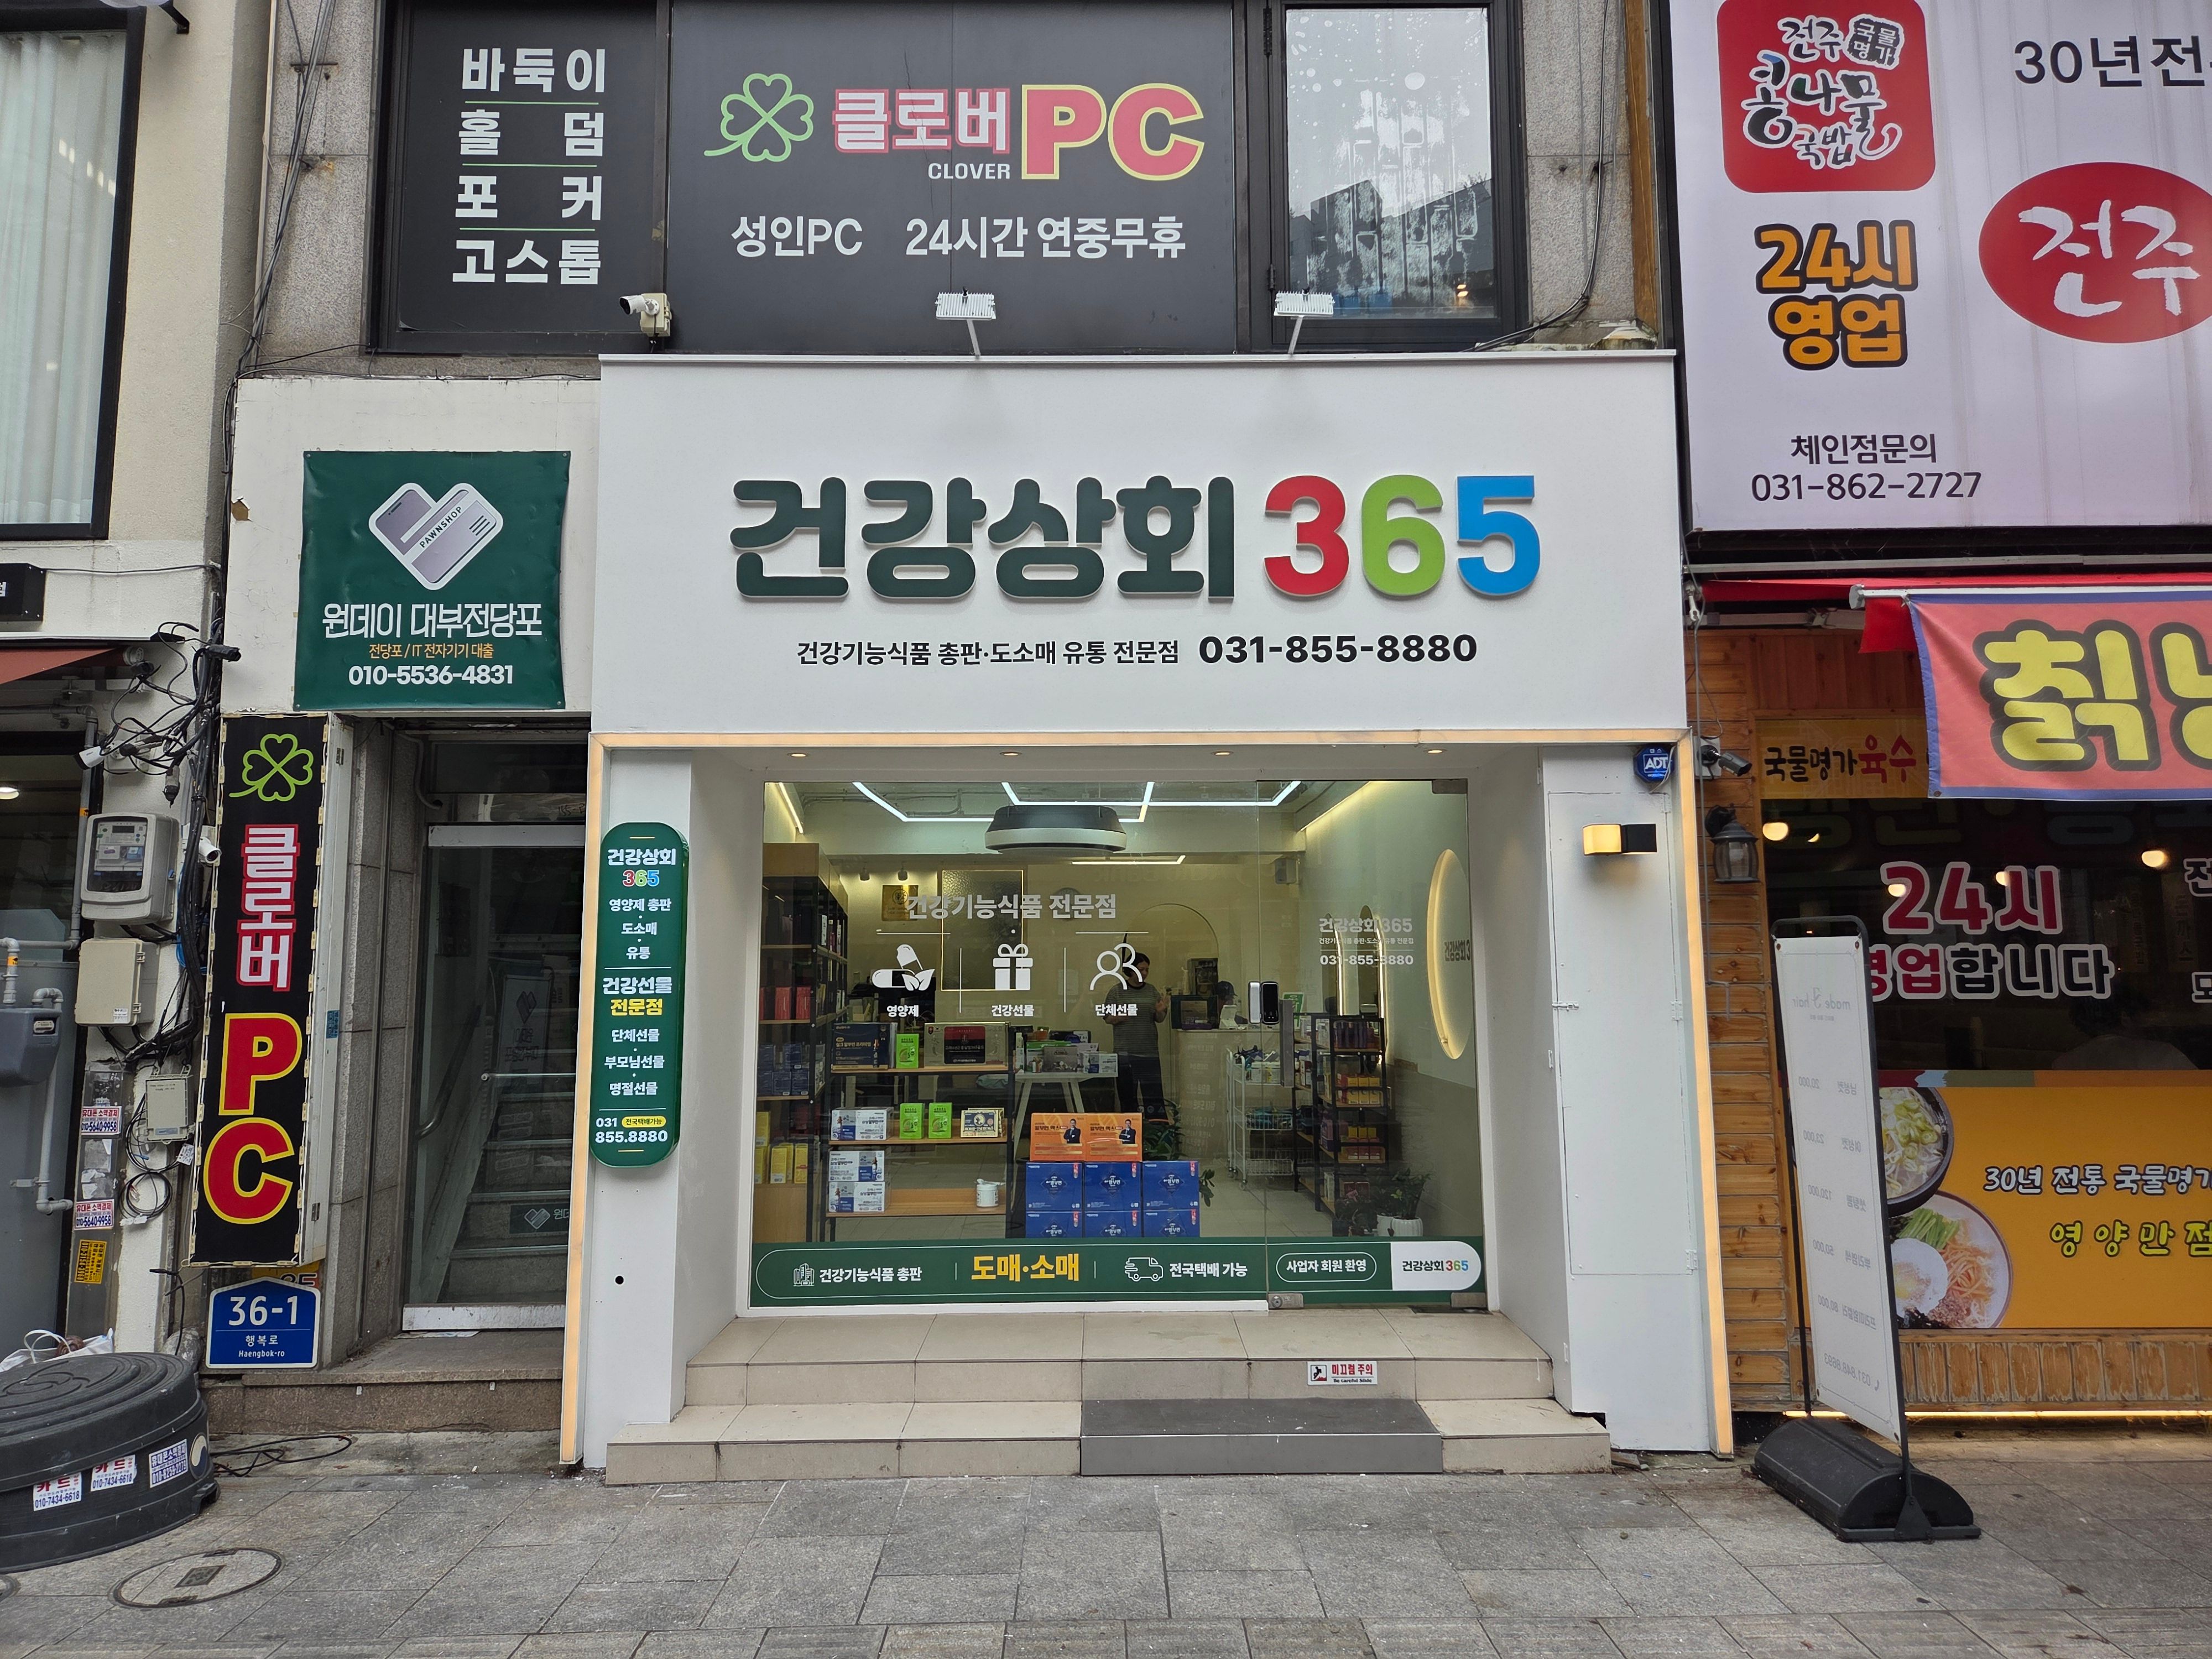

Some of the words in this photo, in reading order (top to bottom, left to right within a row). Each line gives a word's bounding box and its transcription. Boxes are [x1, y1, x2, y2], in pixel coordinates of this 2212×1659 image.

[462, 48, 605, 92] 바둑이
[2014, 36, 2212, 88] 30년전
[1744, 52, 1901, 158] 콩나물
[832, 87, 1010, 154] 클로버
[1021, 83, 1205, 181] PC
[1796, 125, 1854, 166] 국밥
[928, 163, 1010, 180] CLOVER
[732, 216, 863, 258] 성인PC
[906, 216, 1029, 259] 24시간
[1037, 215, 1186, 259] 연중무휴
[453, 240, 601, 285] 고스톱
[1755, 220, 1918, 294] 24시
[2018, 200, 2201, 317] 전주
[1768, 295, 1908, 371] 영업
[1791, 434, 1937, 466] 체인점문의
[1751, 472, 1982, 501] 031-862-2727
[420, 505, 463, 548] PAWNSHOP
[729, 476, 1235, 599] 건강상회
[1264, 473, 1540, 597] 365
[322, 603, 400, 638] 원데이
[410, 603, 542, 638] 대부전당포
[369, 644, 403, 658] 전당포
[424, 643, 468, 658] 전자기기
[471, 643, 494, 659] 대출
[797, 641, 931, 665] 건강기능식품
[937, 641, 1056, 665] 총판·도소매
[1062, 640, 1107, 664] 유통
[1113, 640, 1178, 664] 전문점
[1198, 634, 1478, 665] 031-855-8880
[348, 665, 513, 685] 010-5536-4831
[1644, 757, 1668, 769] ADT
[607, 848, 676, 866] 건강상회
[622, 870, 659, 887] 365
[609, 898, 645, 911] 영양제
[647, 898, 671, 911] 총판
[906, 894, 1042, 919] 건강기능식품
[1048, 894, 1117, 919] 전문점
[1880, 862, 2063, 935] 24시
[236, 824, 300, 992] 클로버
[621, 922, 657, 935] 도소매
[1319, 918, 1378, 933] 건강상회
[1384, 918, 1412, 932] 365
[626, 947, 650, 959] 유통
[603, 977, 672, 994] 건강선물
[611, 998, 662, 1016] 전문점
[886, 1005, 919, 1018] 영양제
[992, 1004, 1034, 1017] 건강선물
[1095, 1004, 1138, 1017] 단체선물
[612, 1029, 660, 1042] 단체선물
[604, 1056, 665, 1069] 부모님선물
[610, 1082, 658, 1096] 명절선물
[203, 1013, 302, 1224] PC
[596, 1118, 617, 1128] 031
[595, 1130, 668, 1143] 855.8880
[1984, 1165, 2042, 1194] 30년
[2053, 1165, 2105, 1196] 전통
[820, 1267, 894, 1283] 건강기능식품
[897, 1267, 922, 1282] 총판
[971, 1254, 1078, 1282] 도매·소매
[1169, 1262, 1219, 1278] 전국택배
[1223, 1262, 1248, 1278] 가능
[1286, 1260, 1318, 1273] 사업자
[1321, 1260, 1342, 1273] 회원
[1344, 1259, 1366, 1272] 환영
[1402, 1260, 1444, 1272] 건강상회
[1446, 1260, 1469, 1271] 365
[228, 1296, 298, 1326] 36-1
[246, 1335, 278, 1347] 행복로
[238, 1350, 285, 1359] Haengbok-ro
[1332, 1364, 1355, 1375] 미끄럼
[1358, 1364, 1373, 1375] 주의
[92, 1473, 132, 1489] 010-7434-6618
[35, 1490, 80, 1509] 010-7434-6618
